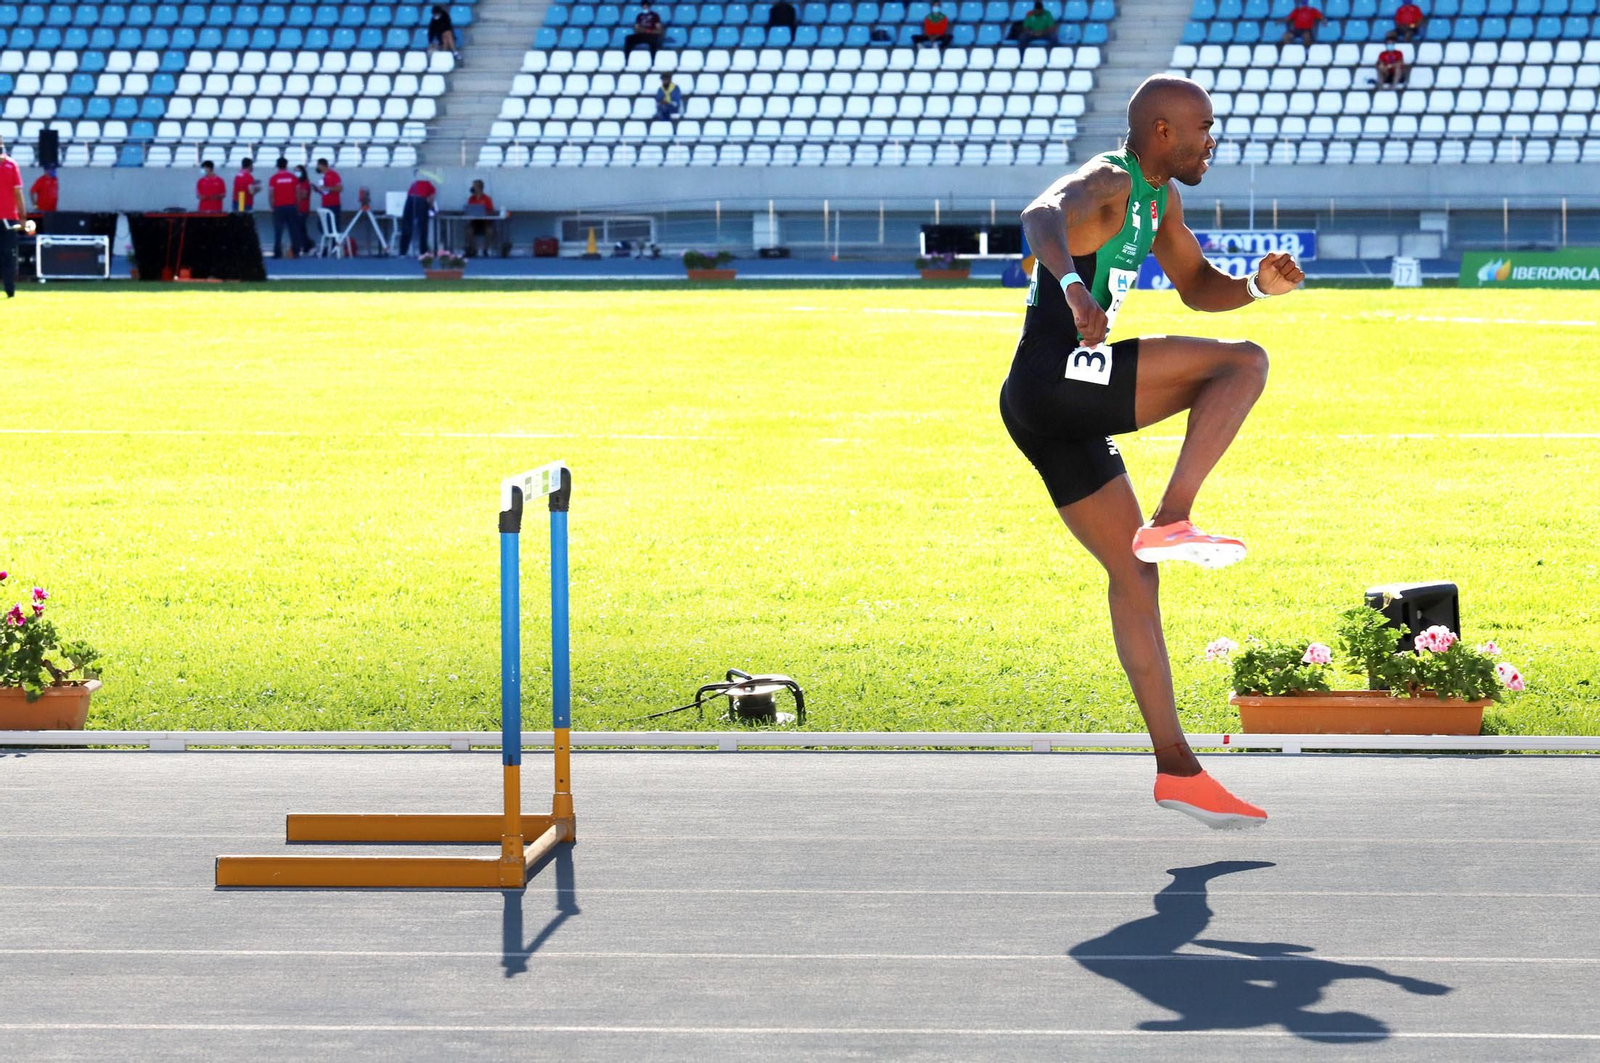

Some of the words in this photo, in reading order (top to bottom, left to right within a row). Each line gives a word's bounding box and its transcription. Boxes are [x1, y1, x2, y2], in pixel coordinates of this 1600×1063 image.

[1398, 267, 1413, 283] 17
[1512, 266, 1600, 281] IBERDROLA
[1074, 350, 1106, 373] 3
